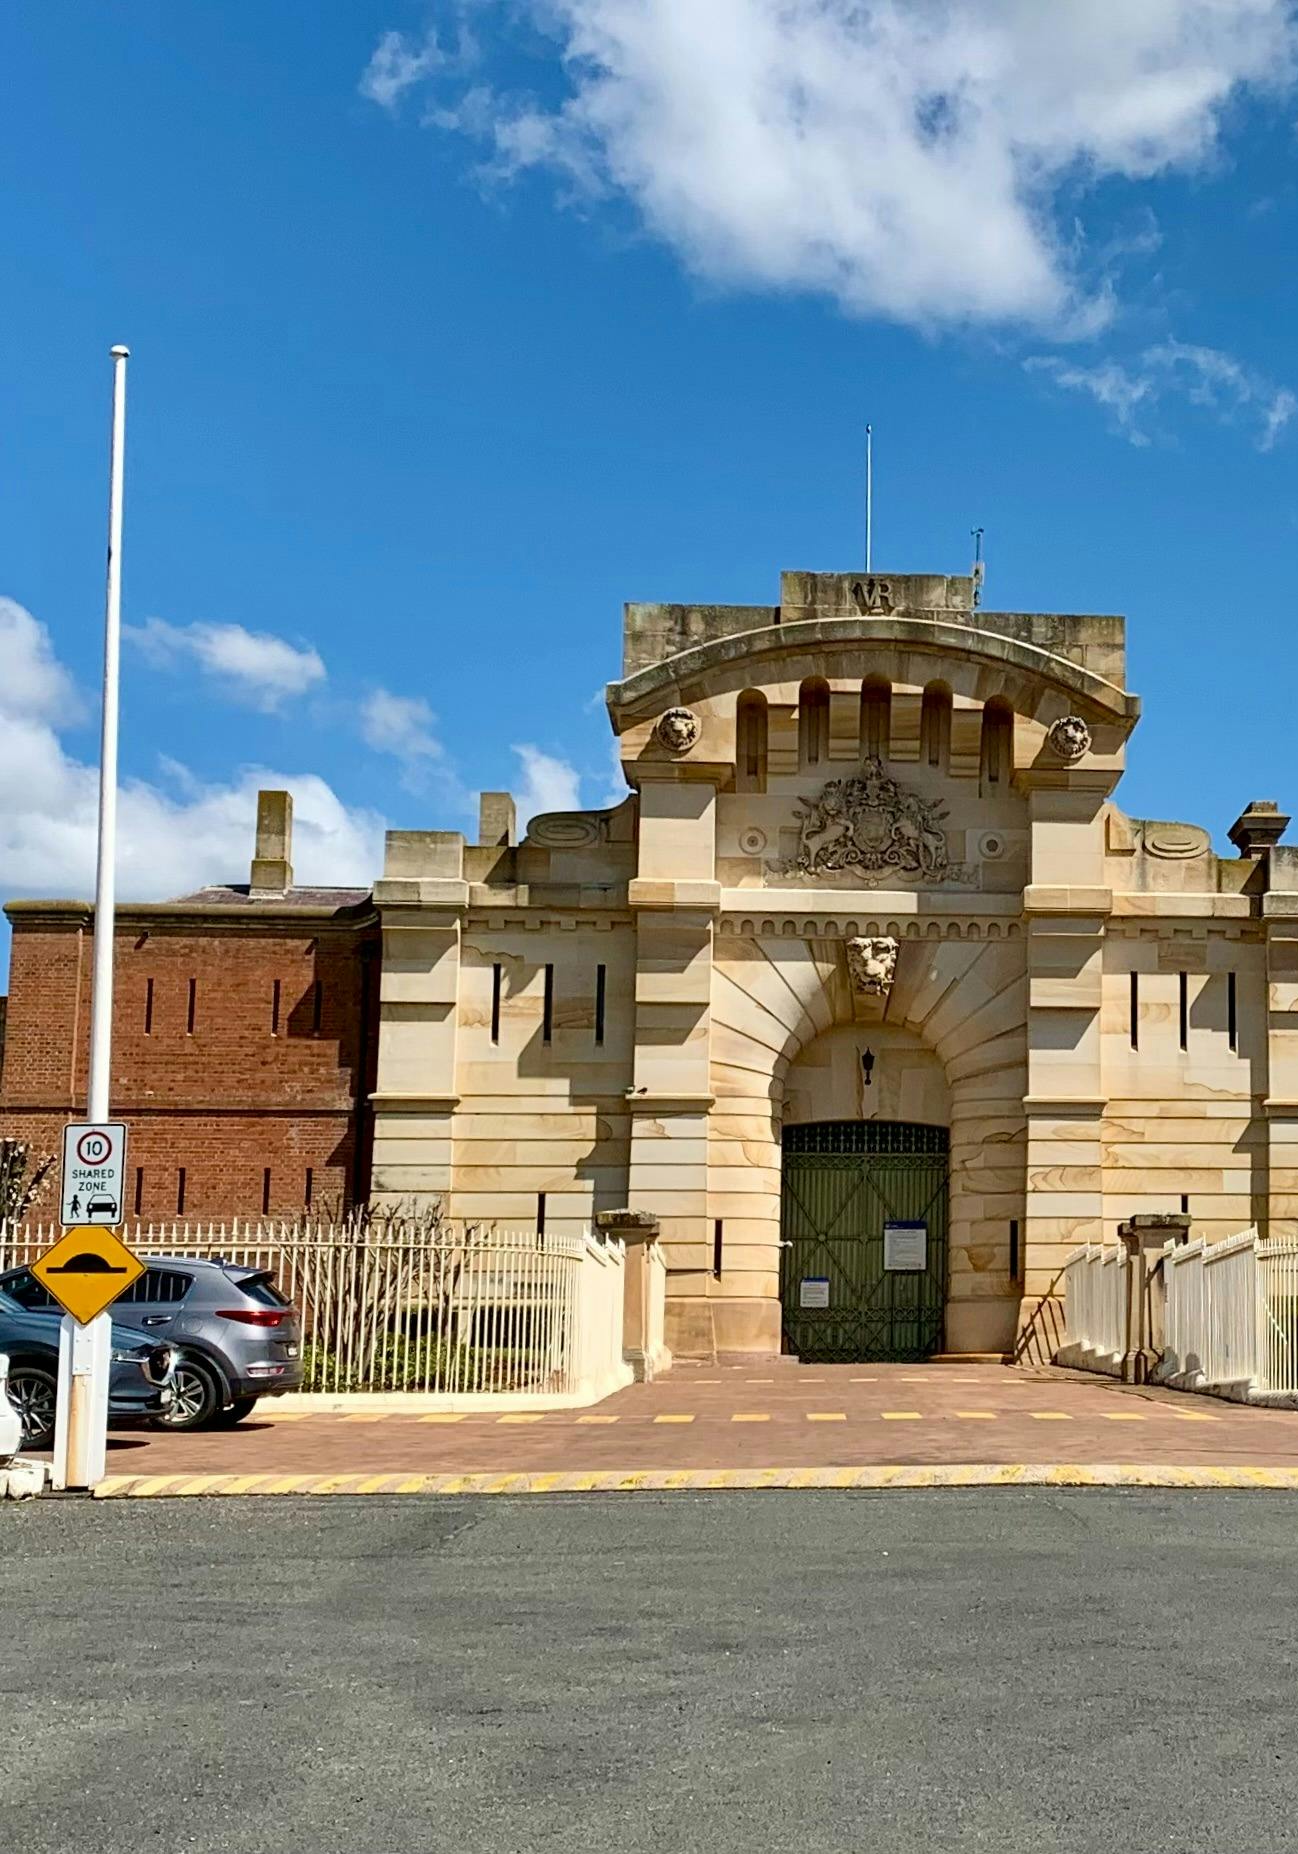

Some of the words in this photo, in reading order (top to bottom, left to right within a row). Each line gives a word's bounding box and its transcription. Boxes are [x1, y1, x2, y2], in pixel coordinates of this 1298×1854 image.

[86, 1141, 103, 1156] 10
[72, 1169, 115, 1179] SHARED
[78, 1182, 107, 1191] ZONE
